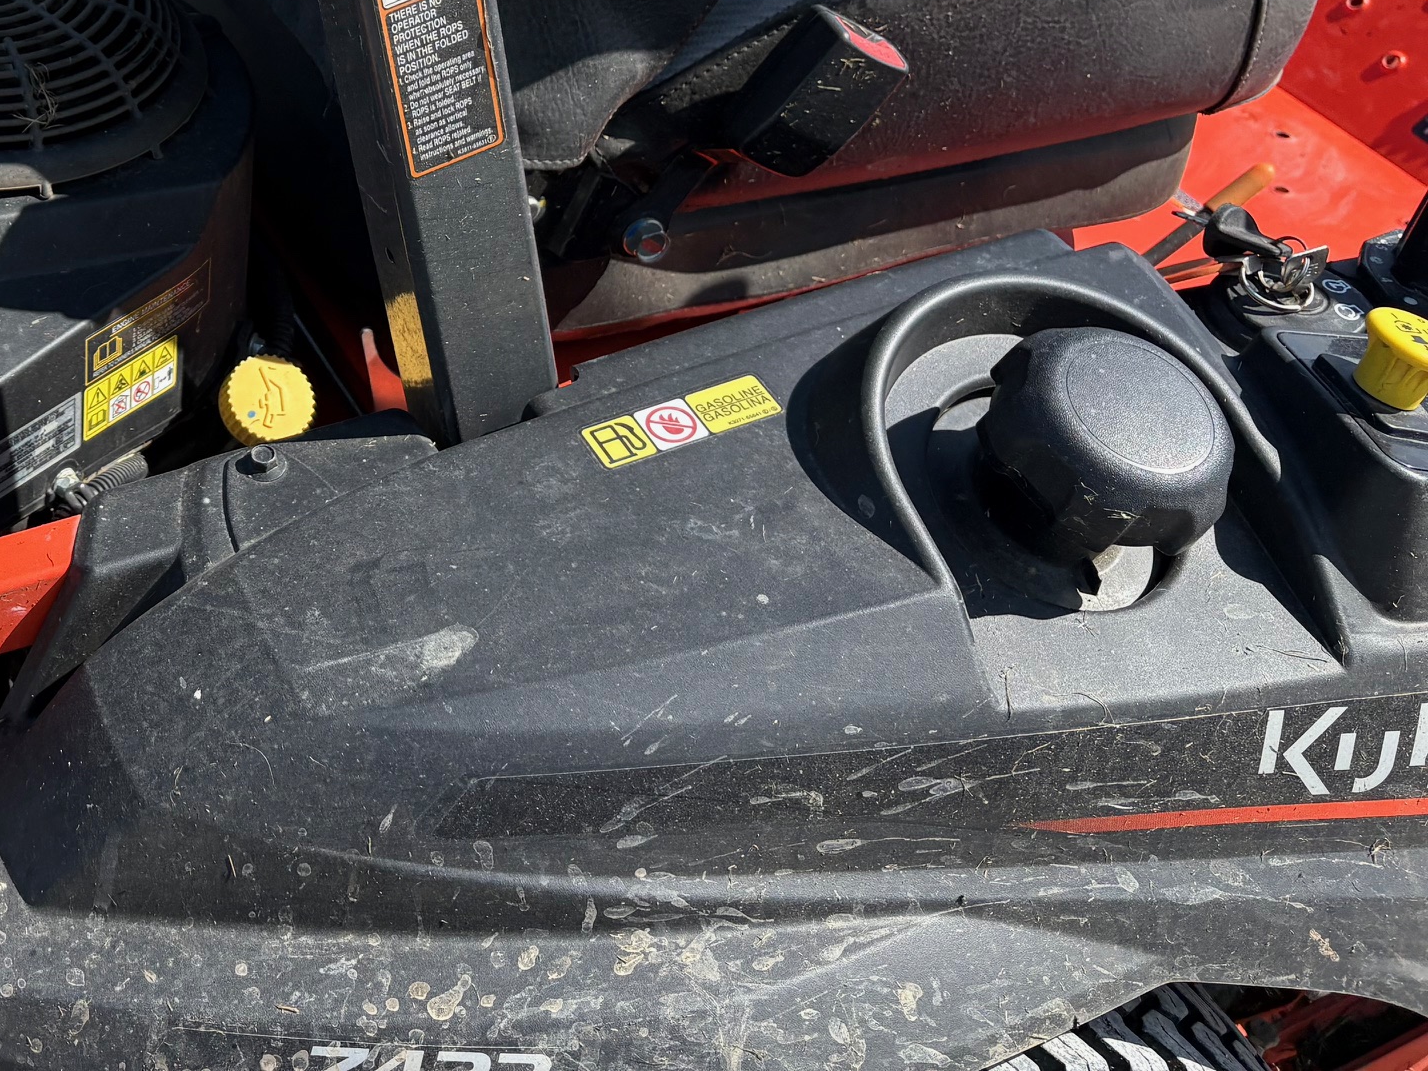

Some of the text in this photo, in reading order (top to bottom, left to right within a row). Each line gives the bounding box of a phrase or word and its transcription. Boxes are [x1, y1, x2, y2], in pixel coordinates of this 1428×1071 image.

[388, 4, 418, 23] THERE
[419, 0, 428, 11] IS
[391, 8, 437, 34] OPERATOR
[393, 15, 447, 45] PROTECTION
[394, 20, 463, 55] WHEN THE ROPS
[397, 29, 469, 66] IS IN THE FOLDED
[399, 53, 441, 76] POSITION.
[404, 72, 423, 84] Check
[423, 67, 433, 76] the
[433, 56, 462, 72] operating
[462, 50, 475, 61] area
[407, 60, 472, 93] and fold the ROPS only
[409, 101, 419, 110] Do
[419, 96, 430, 106] not
[429, 91, 444, 101] wear
[444, 83, 461, 96] SEAT
[461, 76, 477, 89] BELT
[477, 74, 482, 82] if
[424, 77, 455, 95] absolutely
[411, 105, 429, 118] ROPS
[429, 103, 436, 111] is
[413, 116, 430, 127] Raise
[430, 110, 442, 120] and
[442, 105, 455, 116] lock
[455, 97, 473, 110] ROPS
[415, 108, 468, 136] as soon as vertical
[416, 128, 444, 145] clearance
[418, 140, 434, 153] Read
[433, 134, 451, 146] ROPS
[451, 125, 471, 139] related
[420, 142, 454, 161] instructions
[454, 138, 466, 148] and
[112, 311, 140, 334] ENGINE
[141, 279, 191, 316] MAINTENANCE
[695, 385, 763, 413] GASOLINE
[703, 395, 772, 422] GASOLINA
